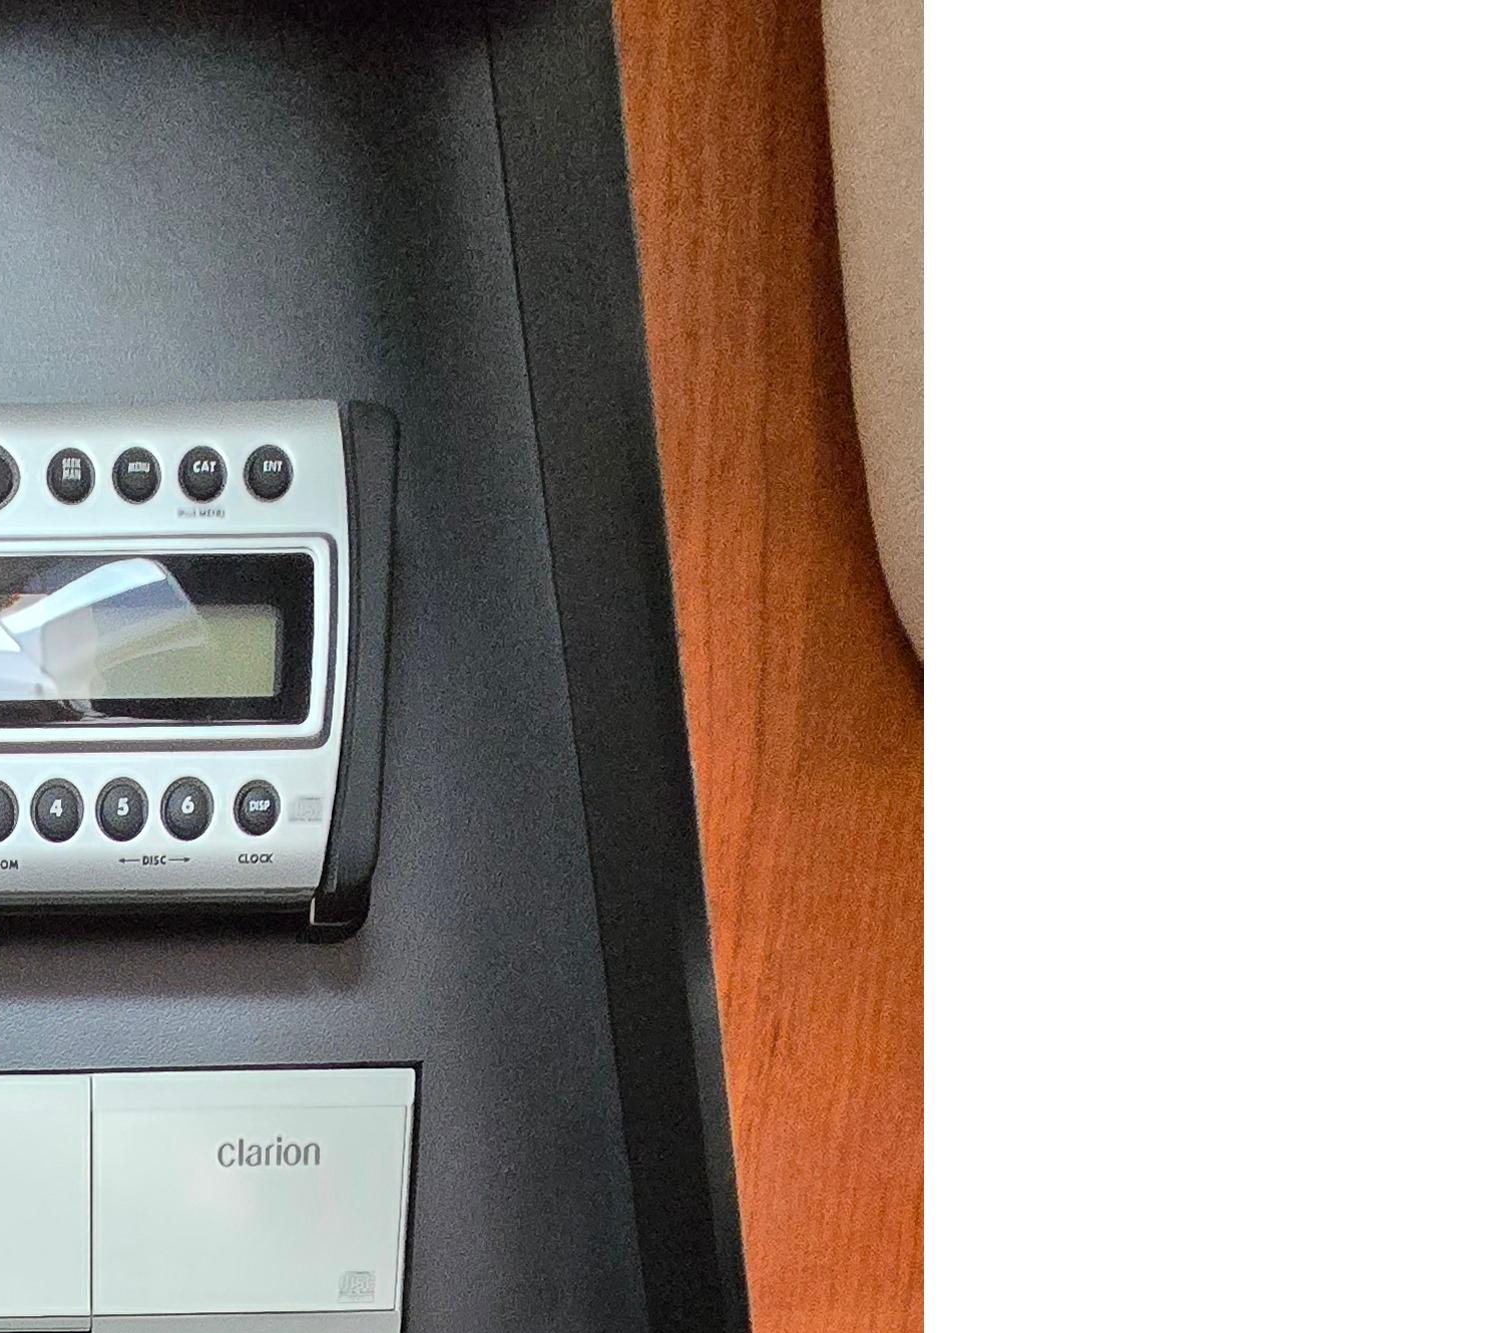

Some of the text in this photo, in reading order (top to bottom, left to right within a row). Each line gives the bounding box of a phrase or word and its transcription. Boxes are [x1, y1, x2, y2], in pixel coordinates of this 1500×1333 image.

[128, 461, 150, 473] MENU
[193, 461, 216, 473] CAT
[263, 461, 282, 472] ENT
[50, 799, 62, 816] 4
[117, 799, 129, 816] 5
[181, 797, 193, 814] 6
[249, 799, 270, 812] DISP
[143, 855, 166, 866] DISC
[238, 853, 272, 864] CLOCK
[217, 1136, 321, 1168] clarion
